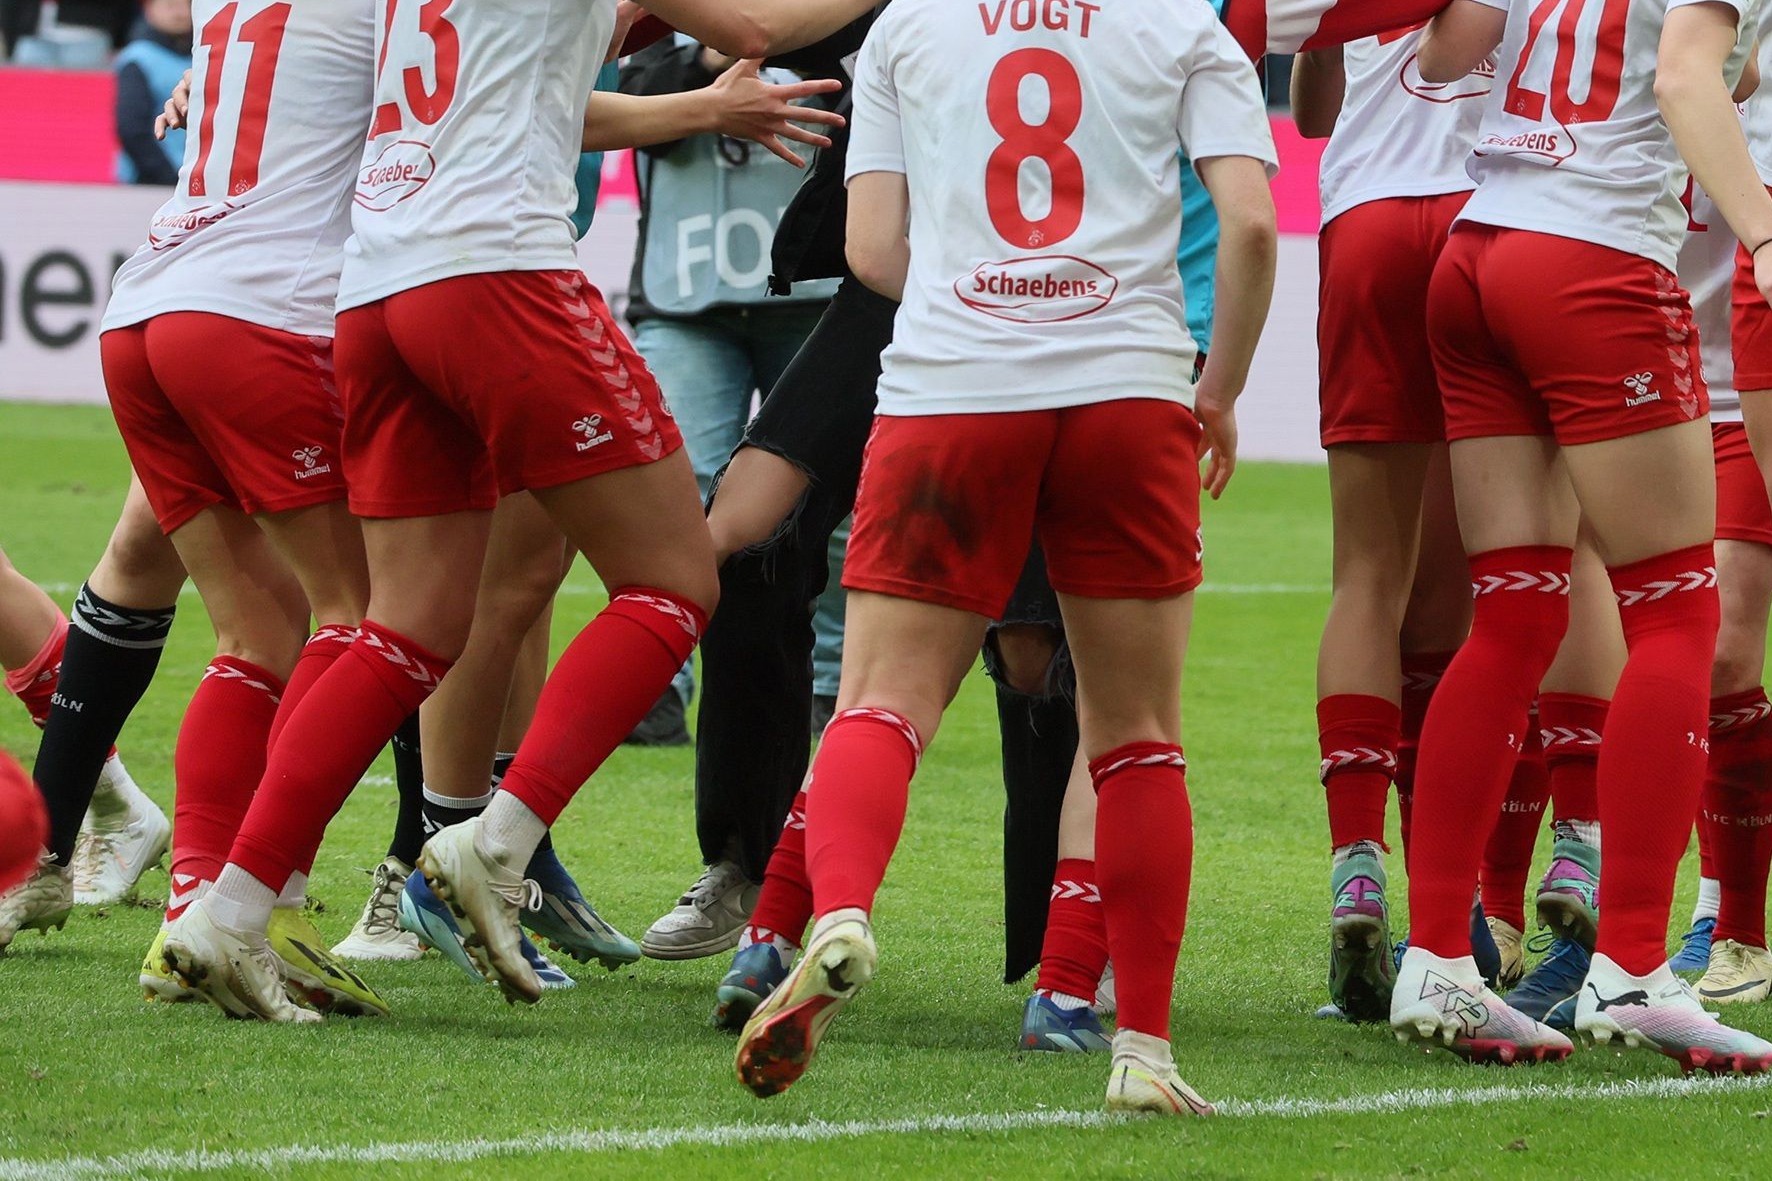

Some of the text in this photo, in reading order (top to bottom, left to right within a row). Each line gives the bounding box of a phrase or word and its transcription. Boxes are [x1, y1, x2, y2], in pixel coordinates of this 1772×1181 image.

[188, 1, 293, 197] 11
[984, 47, 1085, 250] 8
[973, 270, 1097, 299] Schaebens
[1625, 390, 1661, 407] hummel
[294, 464, 331, 480] hummel
[51, 692, 84, 713] ÖLN
